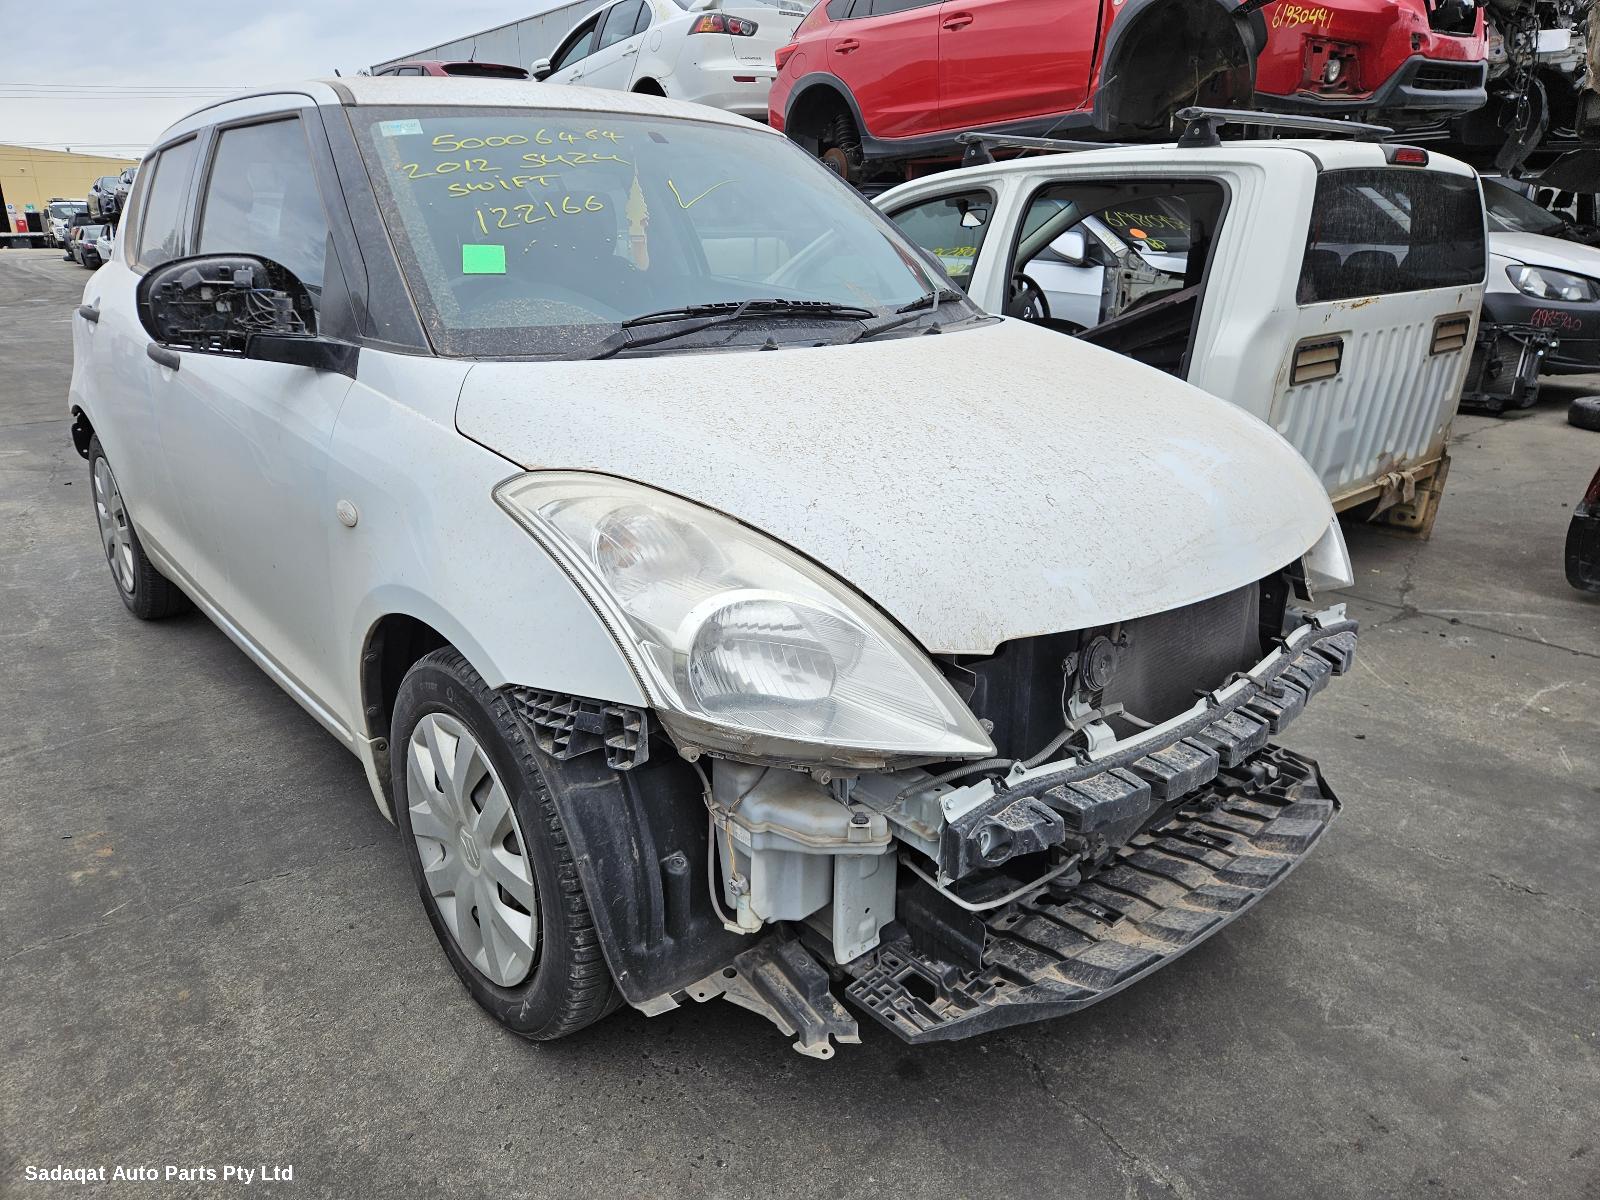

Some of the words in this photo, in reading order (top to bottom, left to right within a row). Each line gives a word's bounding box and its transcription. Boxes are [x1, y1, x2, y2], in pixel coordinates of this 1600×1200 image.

[1272, 4, 1334, 29] 61930441
[432, 128, 624, 152] 50006464
[403, 158, 502, 179] 2012
[475, 195, 604, 235] 122166
